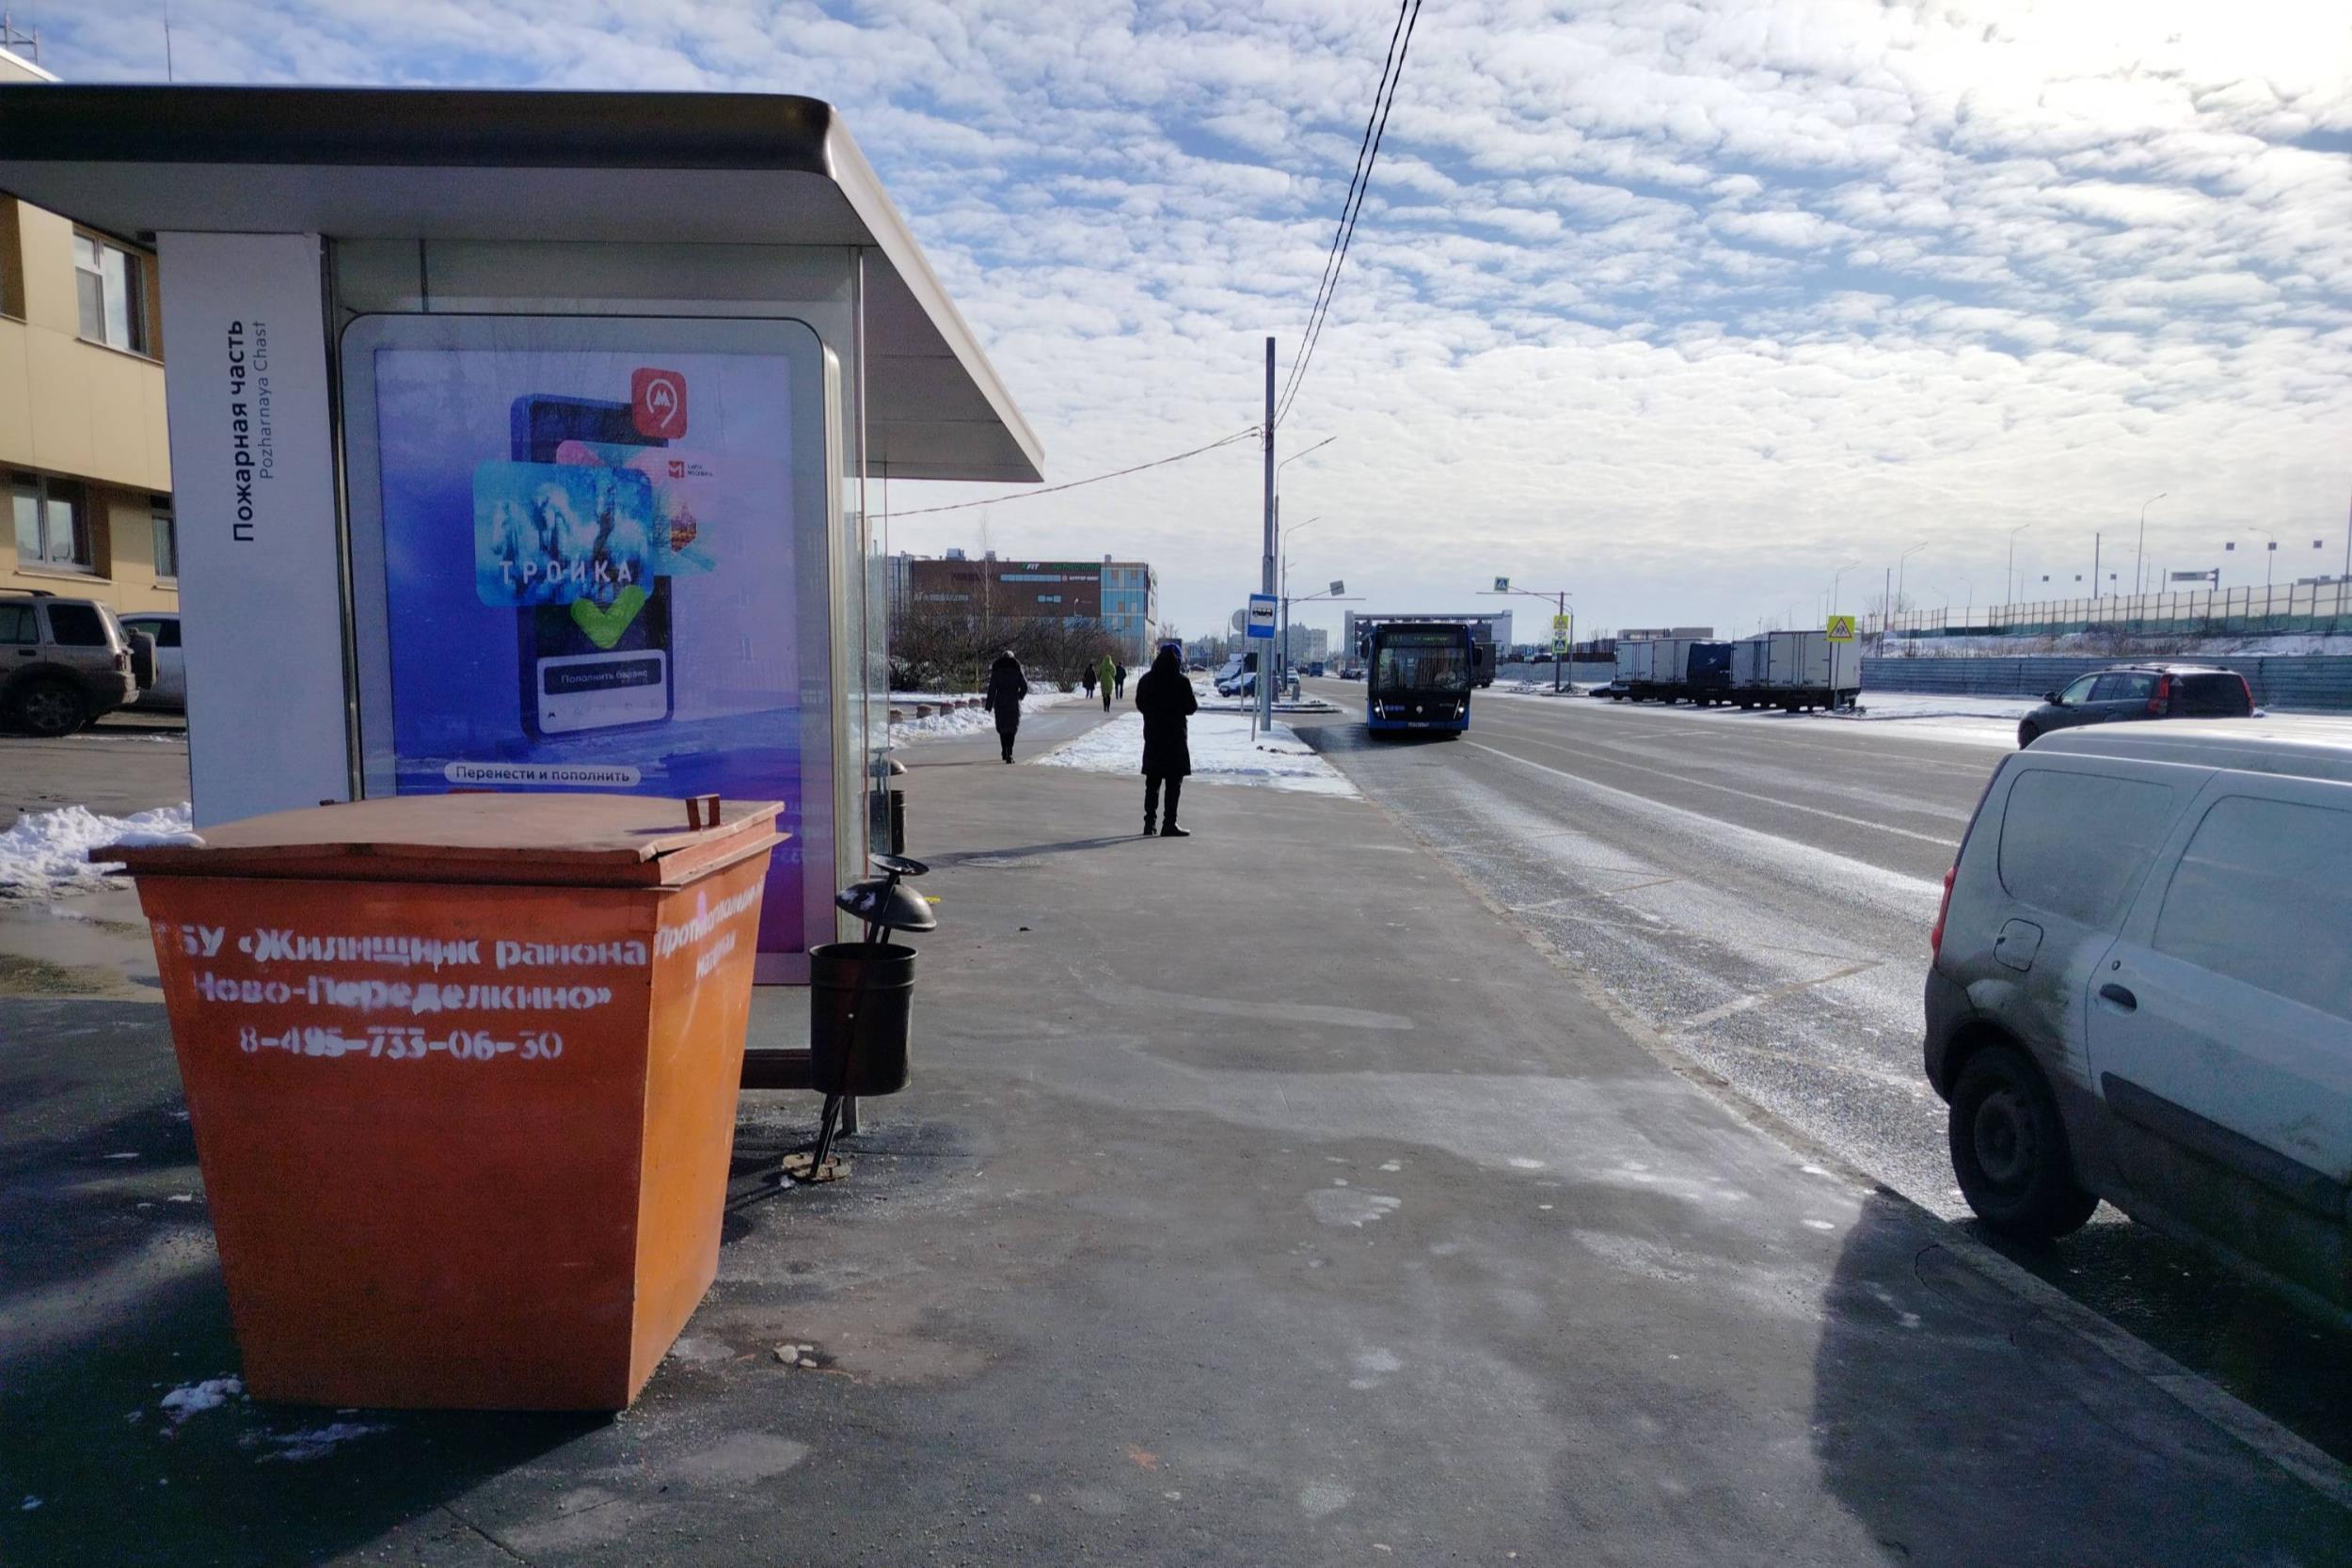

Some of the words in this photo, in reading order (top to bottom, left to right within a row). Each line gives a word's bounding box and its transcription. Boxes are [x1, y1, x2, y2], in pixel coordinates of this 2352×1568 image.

[228, 321, 245, 394] часть
[253, 321, 268, 372] Chast
[258, 377, 273, 480] Pozharnaya
[232, 403, 255, 542] Пожарная
[561, 672, 614, 685] Пополнить
[616, 668, 648, 680] баланс
[455, 766, 535, 782] Перенести
[539, 771, 548, 781] и
[551, 769, 630, 783] пополнить
[240, 1025, 564, 1060] 8-495-733-06-30
